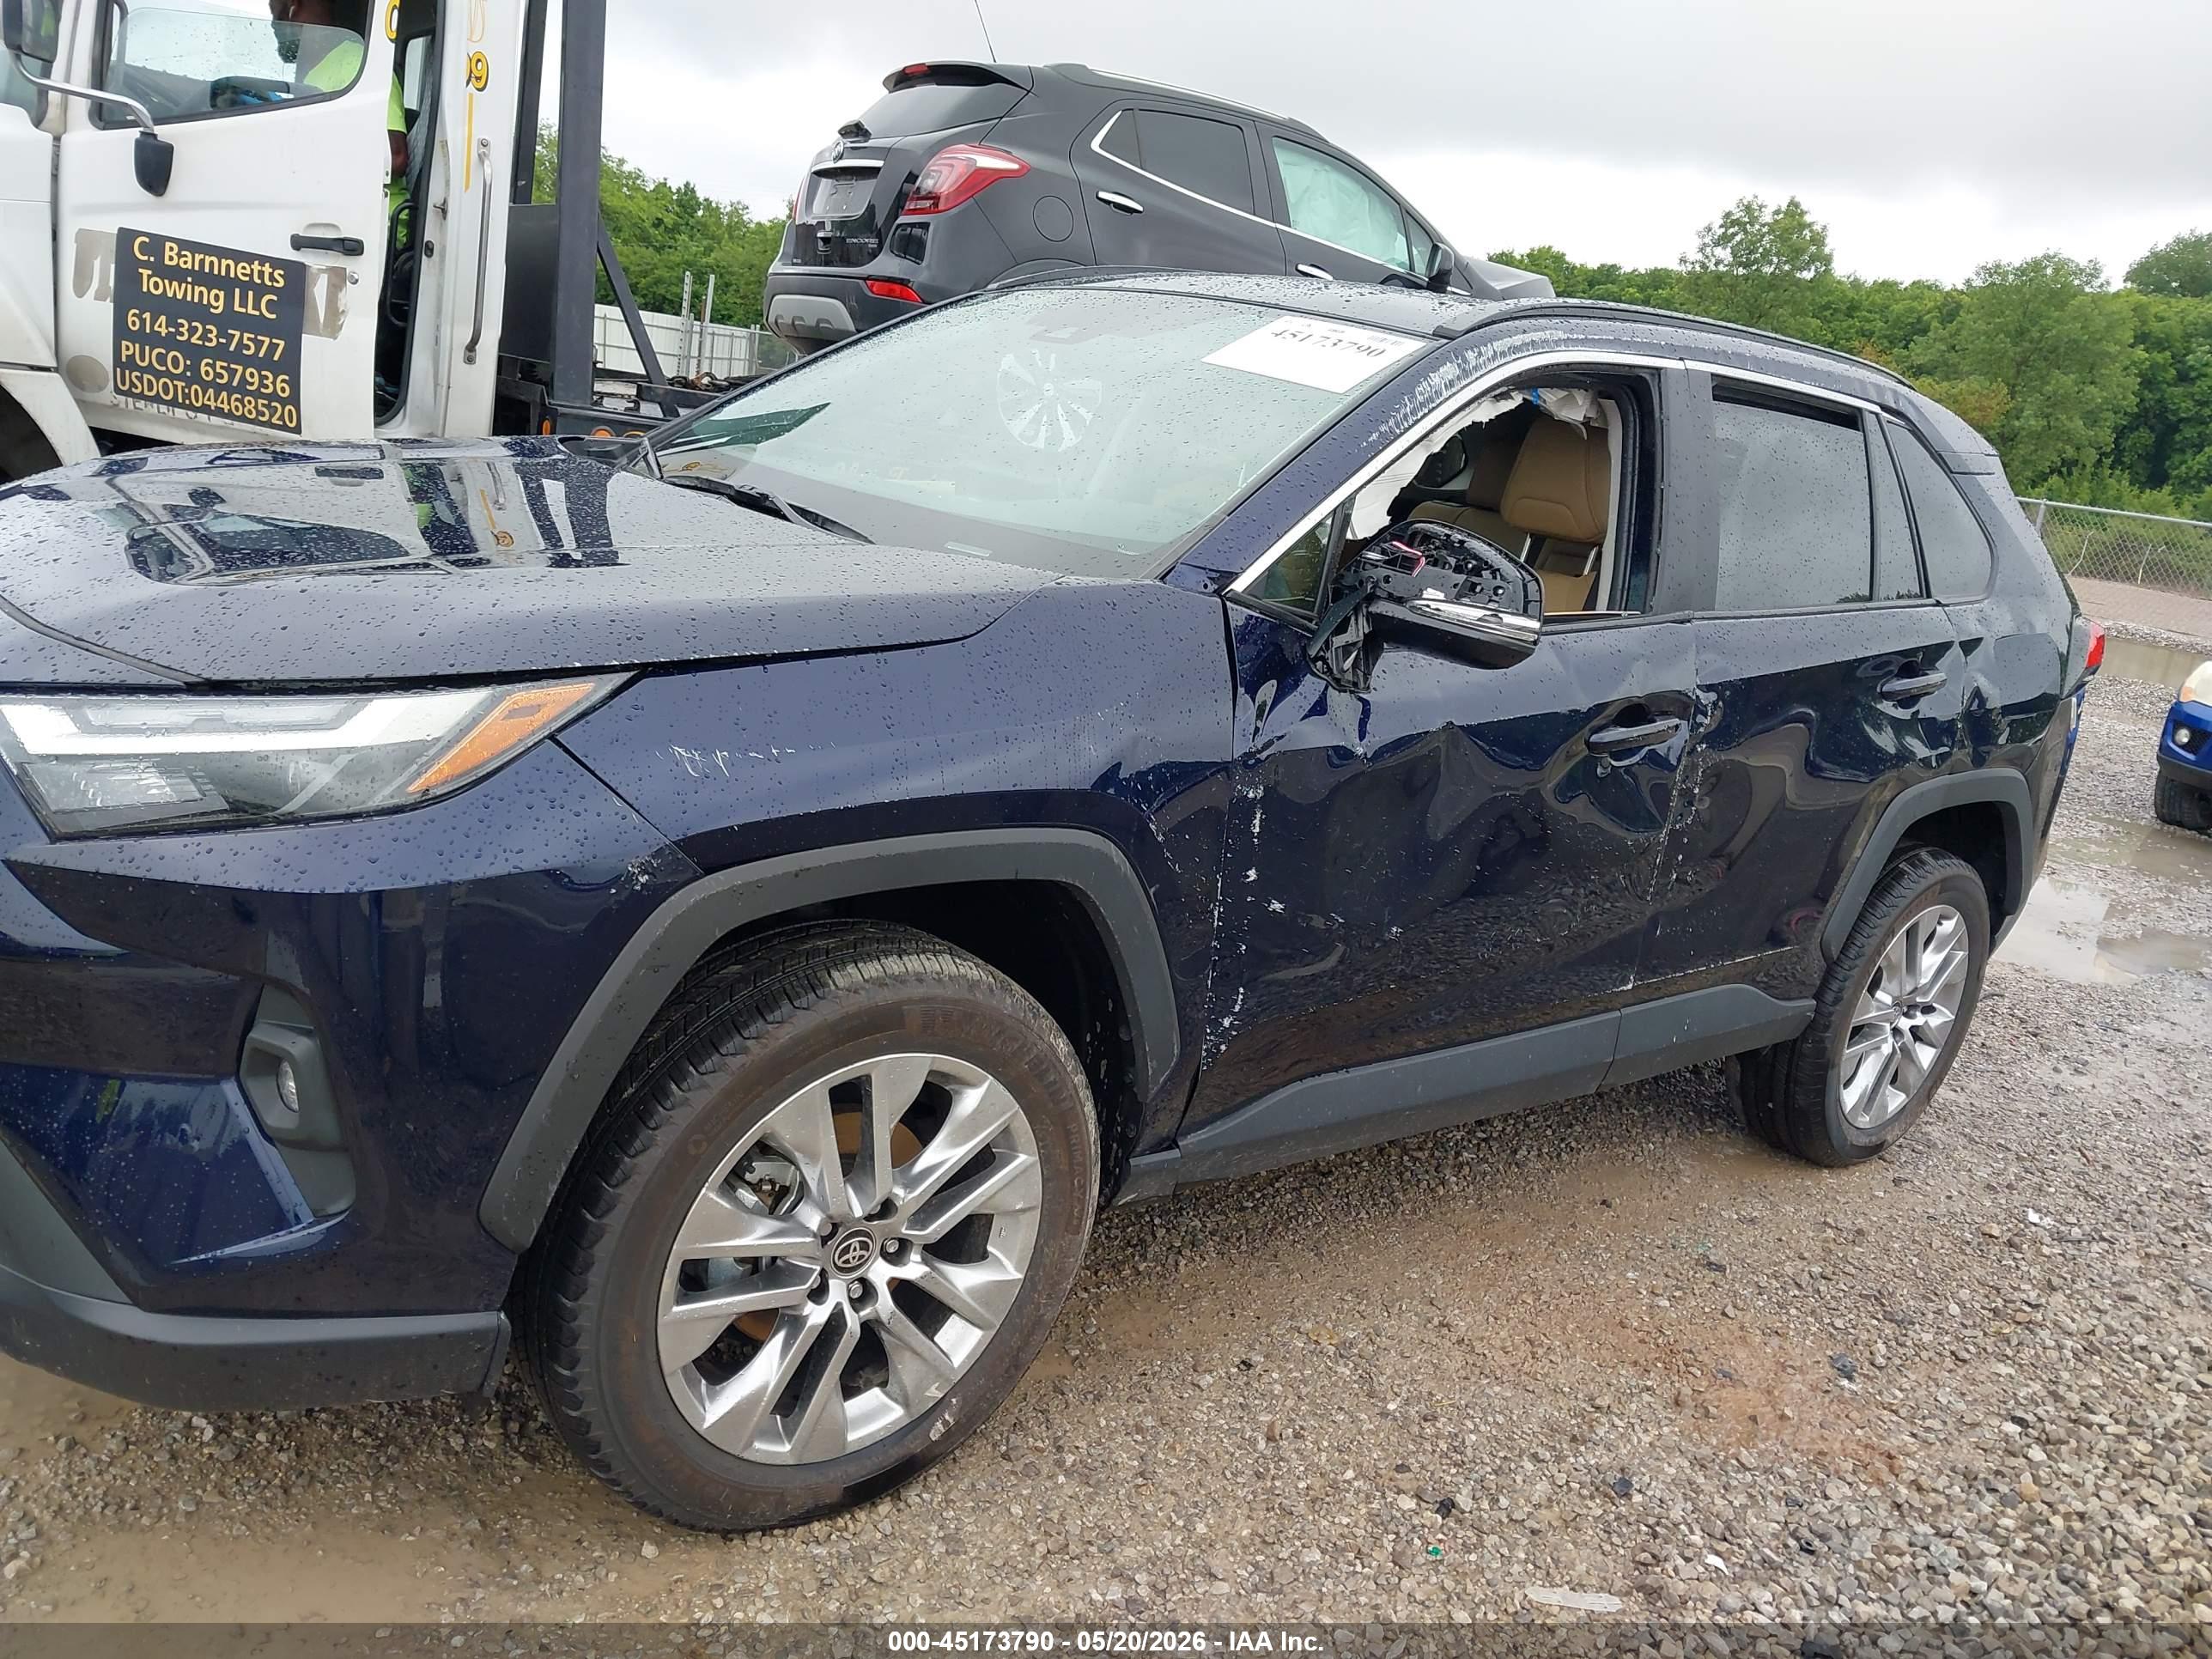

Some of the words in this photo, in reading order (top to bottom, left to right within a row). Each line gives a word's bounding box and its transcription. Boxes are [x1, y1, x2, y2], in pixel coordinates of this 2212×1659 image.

[133, 236, 155, 262] C.
[164, 241, 285, 288] Barnnetts
[137, 268, 224, 313] Towing
[234, 289, 277, 319] LLC
[127, 309, 285, 362] 614-323-7577
[121, 340, 191, 376] PUCO:
[199, 358, 290, 398] 657936
[116, 368, 297, 428] USDOT:04468520
